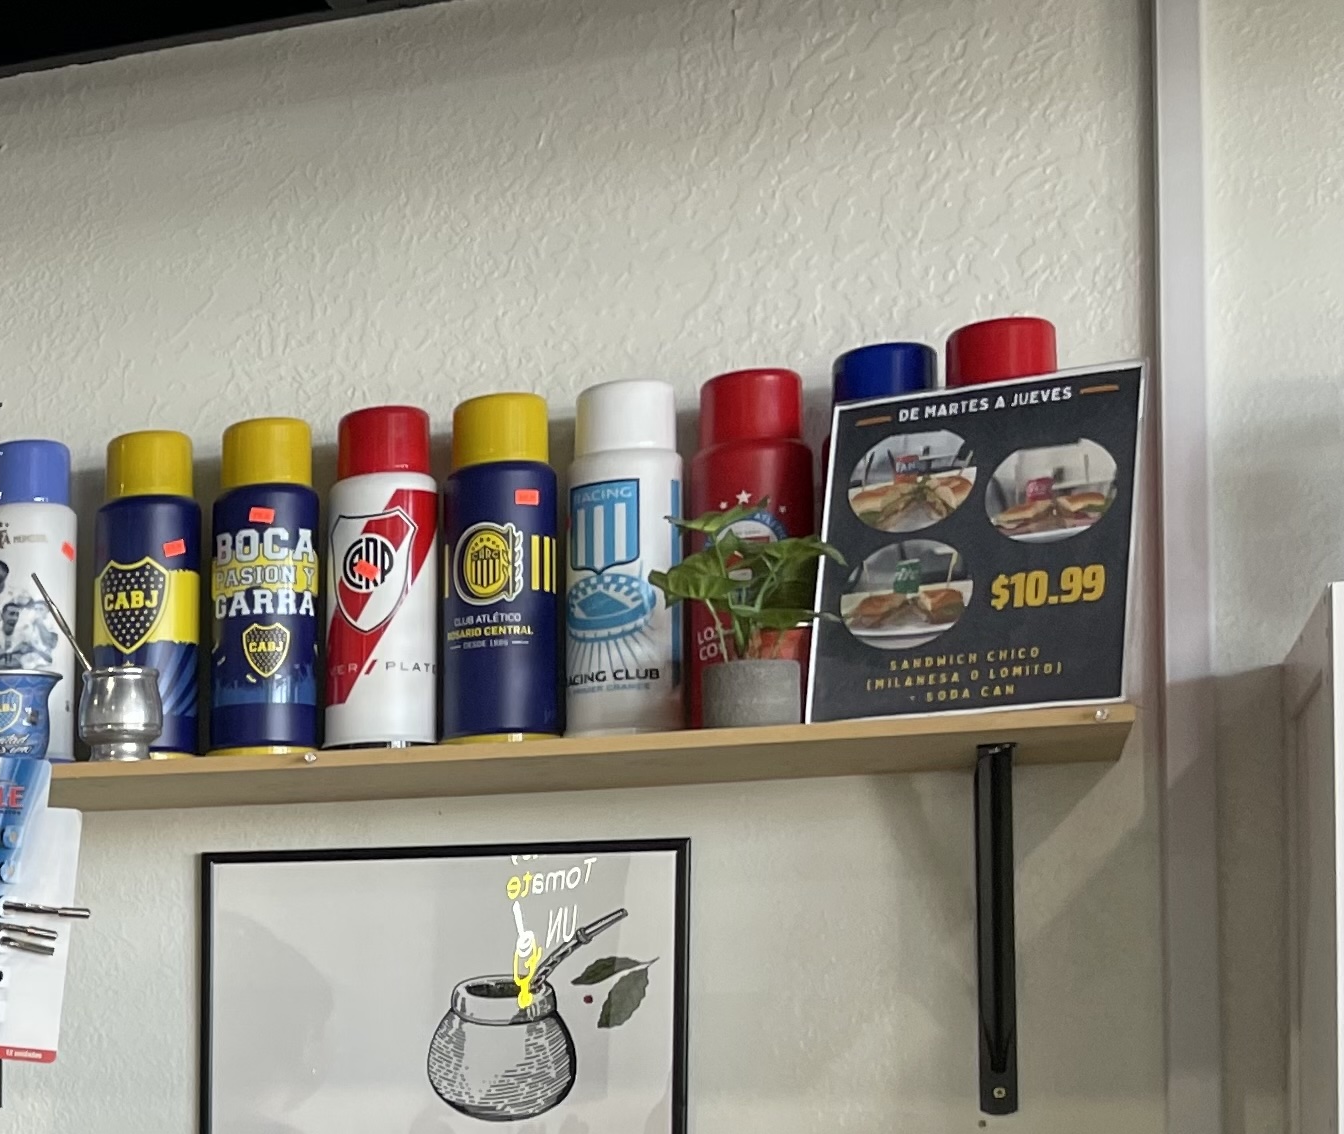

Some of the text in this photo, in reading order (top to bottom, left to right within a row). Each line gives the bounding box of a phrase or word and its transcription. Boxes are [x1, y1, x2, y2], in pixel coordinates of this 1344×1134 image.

[898, 386, 1072, 423] DE MARTES A JUEVES
[216, 527, 316, 565] BOCA
[216, 564, 297, 590] PASION
[990, 563, 1106, 611] $10.99
[104, 589, 158, 610] CABJ
[215, 588, 316, 619] GARRA
[454, 611, 522, 627] CLUB ATLÉTICO
[483, 625, 534, 637] CENTRAL
[249, 641, 285, 653] CABJ
[889, 646, 1041, 672] SANDWICH CHICO
[612, 667, 661, 681] CLUB
[980, 683, 1016, 697] CAN
